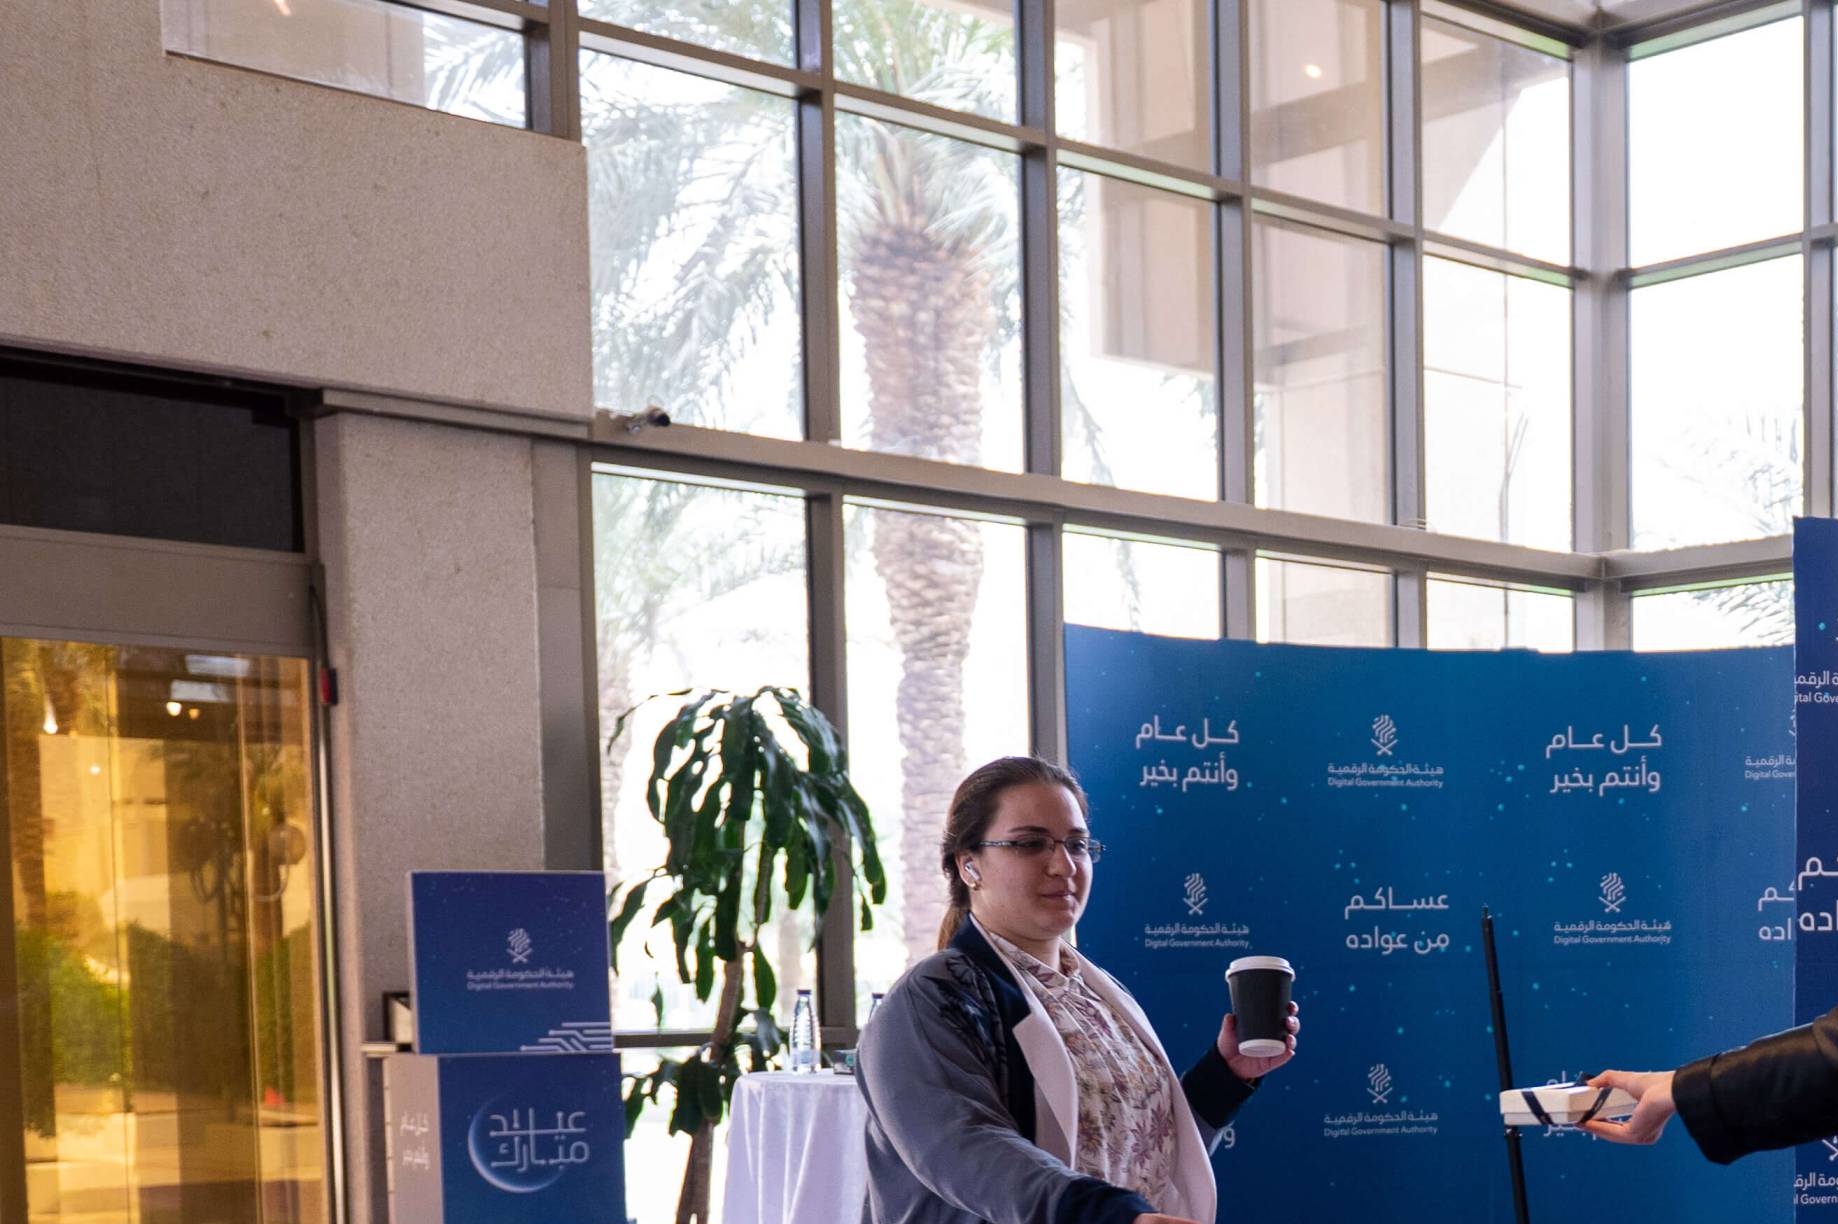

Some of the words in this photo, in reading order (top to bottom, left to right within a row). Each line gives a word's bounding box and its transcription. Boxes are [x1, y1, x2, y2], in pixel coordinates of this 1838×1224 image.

[1795, 671, 1830, 689] الرقم
[1135, 715, 1188, 749] عام
[1192, 718, 1239, 749] كل
[1545, 725, 1605, 759] عام
[1610, 724, 1662, 755] كل
[1139, 759, 1177, 787] بخير
[1182, 752, 1239, 791] وأنتم
[1550, 766, 1594, 794] بخير
[1599, 755, 1661, 796] وأنتم
[1344, 886, 1449, 919] عساكم
[1345, 925, 1407, 955] عواده
[1413, 930, 1450, 955] من
[1758, 917, 1793, 941] اده
[1794, 1172, 1816, 1190] الرق
